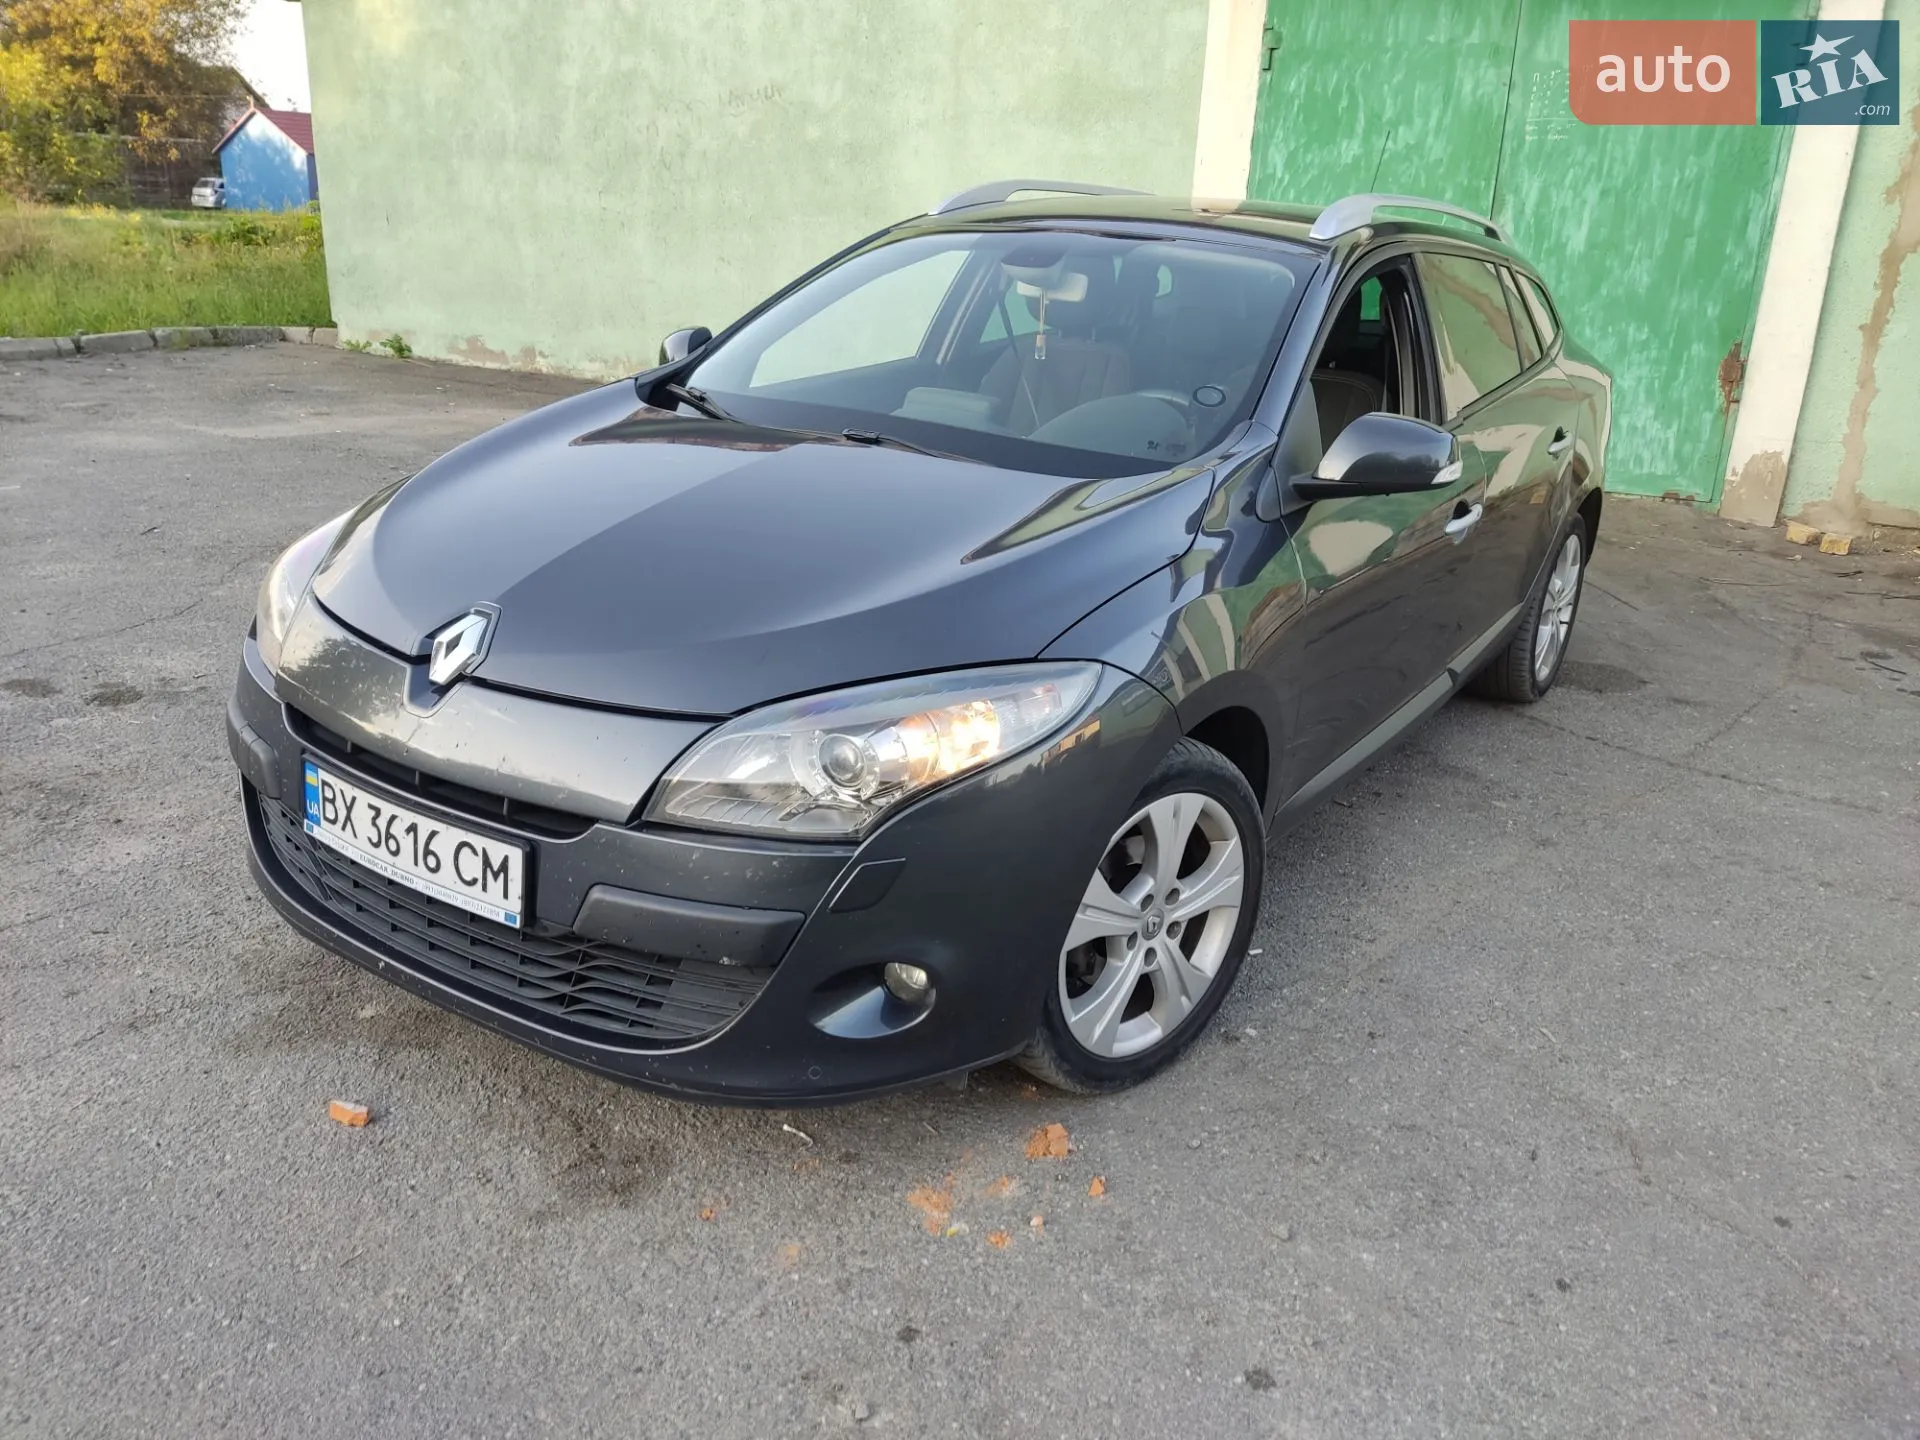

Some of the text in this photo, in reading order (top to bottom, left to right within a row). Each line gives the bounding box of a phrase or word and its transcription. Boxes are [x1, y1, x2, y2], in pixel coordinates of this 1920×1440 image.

[307, 800, 320, 817] UA
[320, 778, 509, 900] BX 3616 CM
